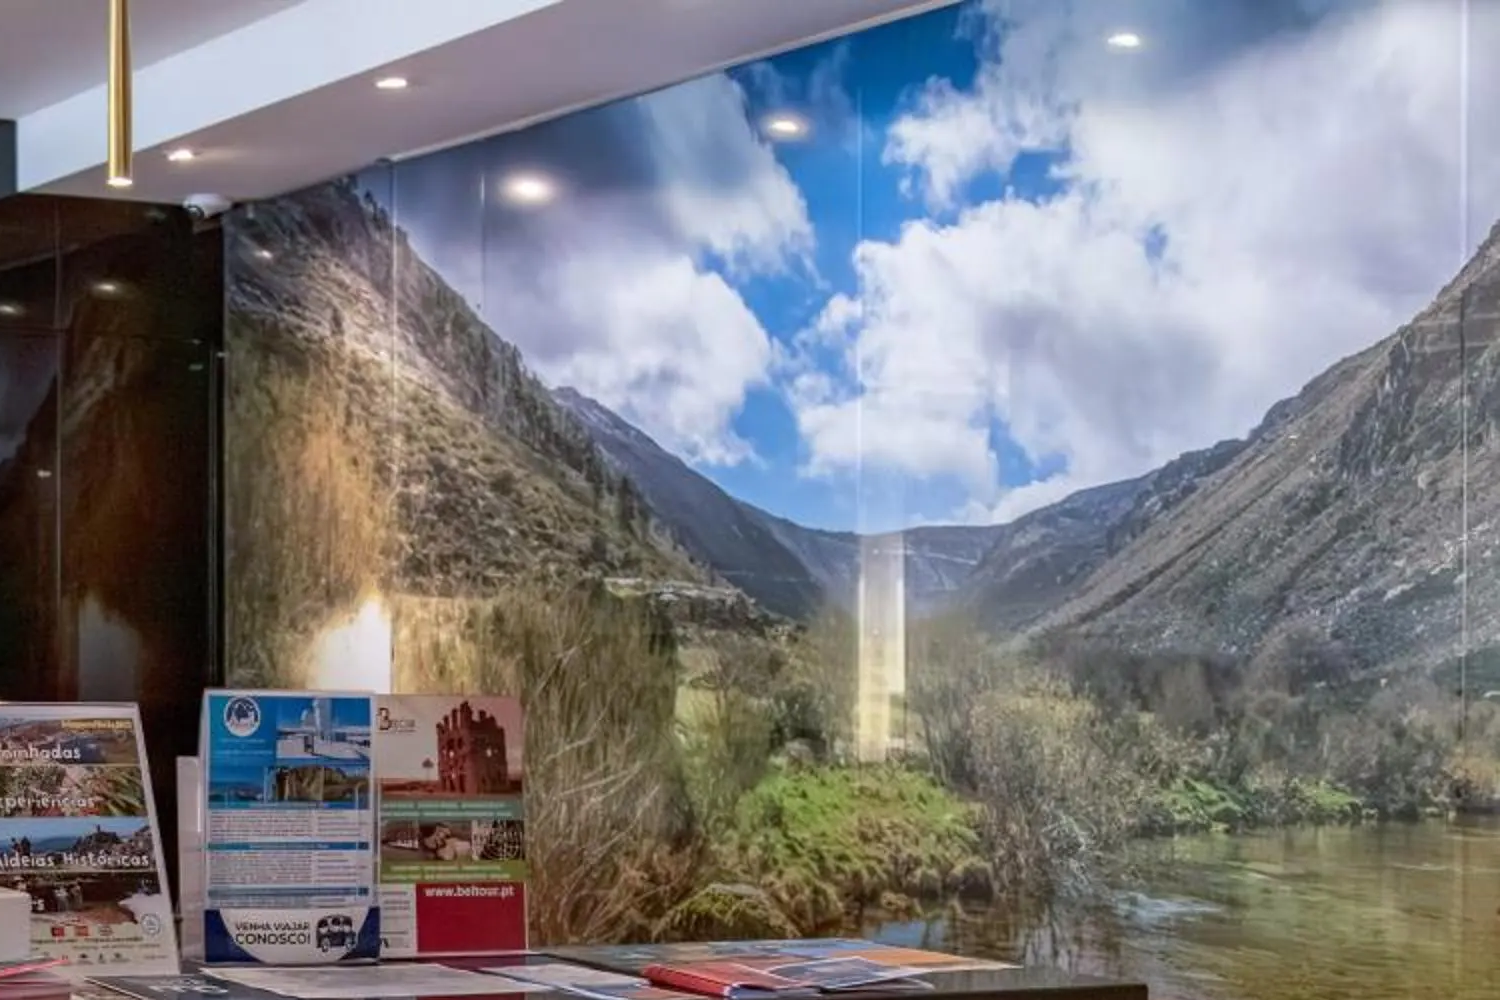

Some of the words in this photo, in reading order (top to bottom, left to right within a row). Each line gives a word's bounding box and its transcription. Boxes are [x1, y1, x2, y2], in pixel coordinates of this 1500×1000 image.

[63, 849, 150, 868] Históricas
[235, 922, 272, 931] VENHA
[235, 932, 311, 946] CONOSCO!
